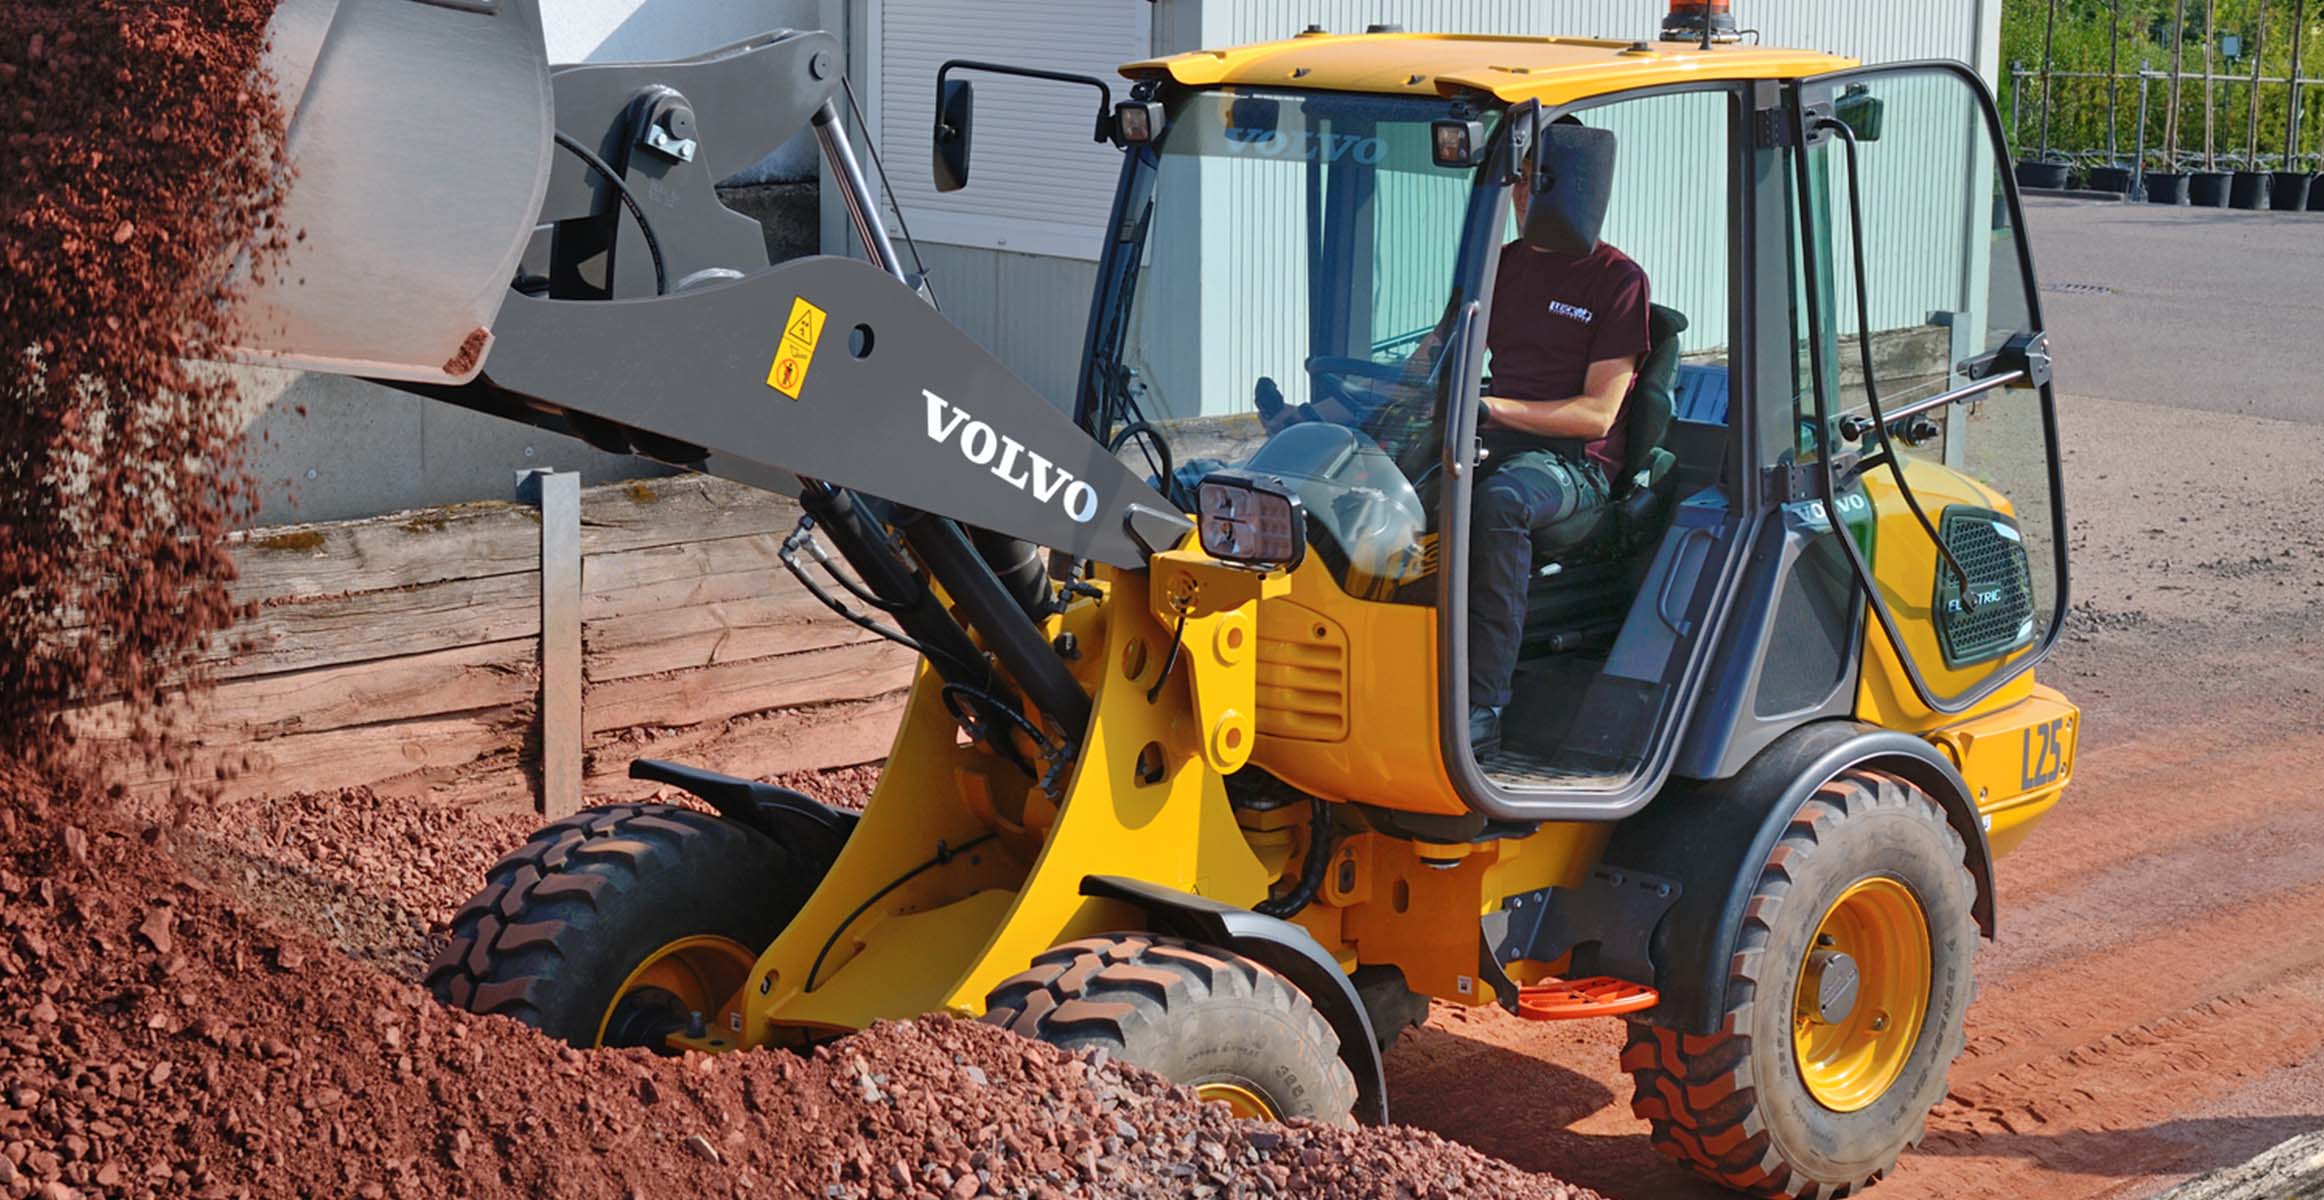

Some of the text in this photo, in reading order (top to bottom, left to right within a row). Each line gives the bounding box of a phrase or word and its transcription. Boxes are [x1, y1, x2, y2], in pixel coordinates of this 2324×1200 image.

[1224, 127, 1389, 165] VOLVO
[921, 387, 1099, 523] VOLVO
[1790, 494, 1865, 519] VOVO
[1948, 589, 2001, 613] ELTRIC
[2021, 717, 2064, 791] L25
